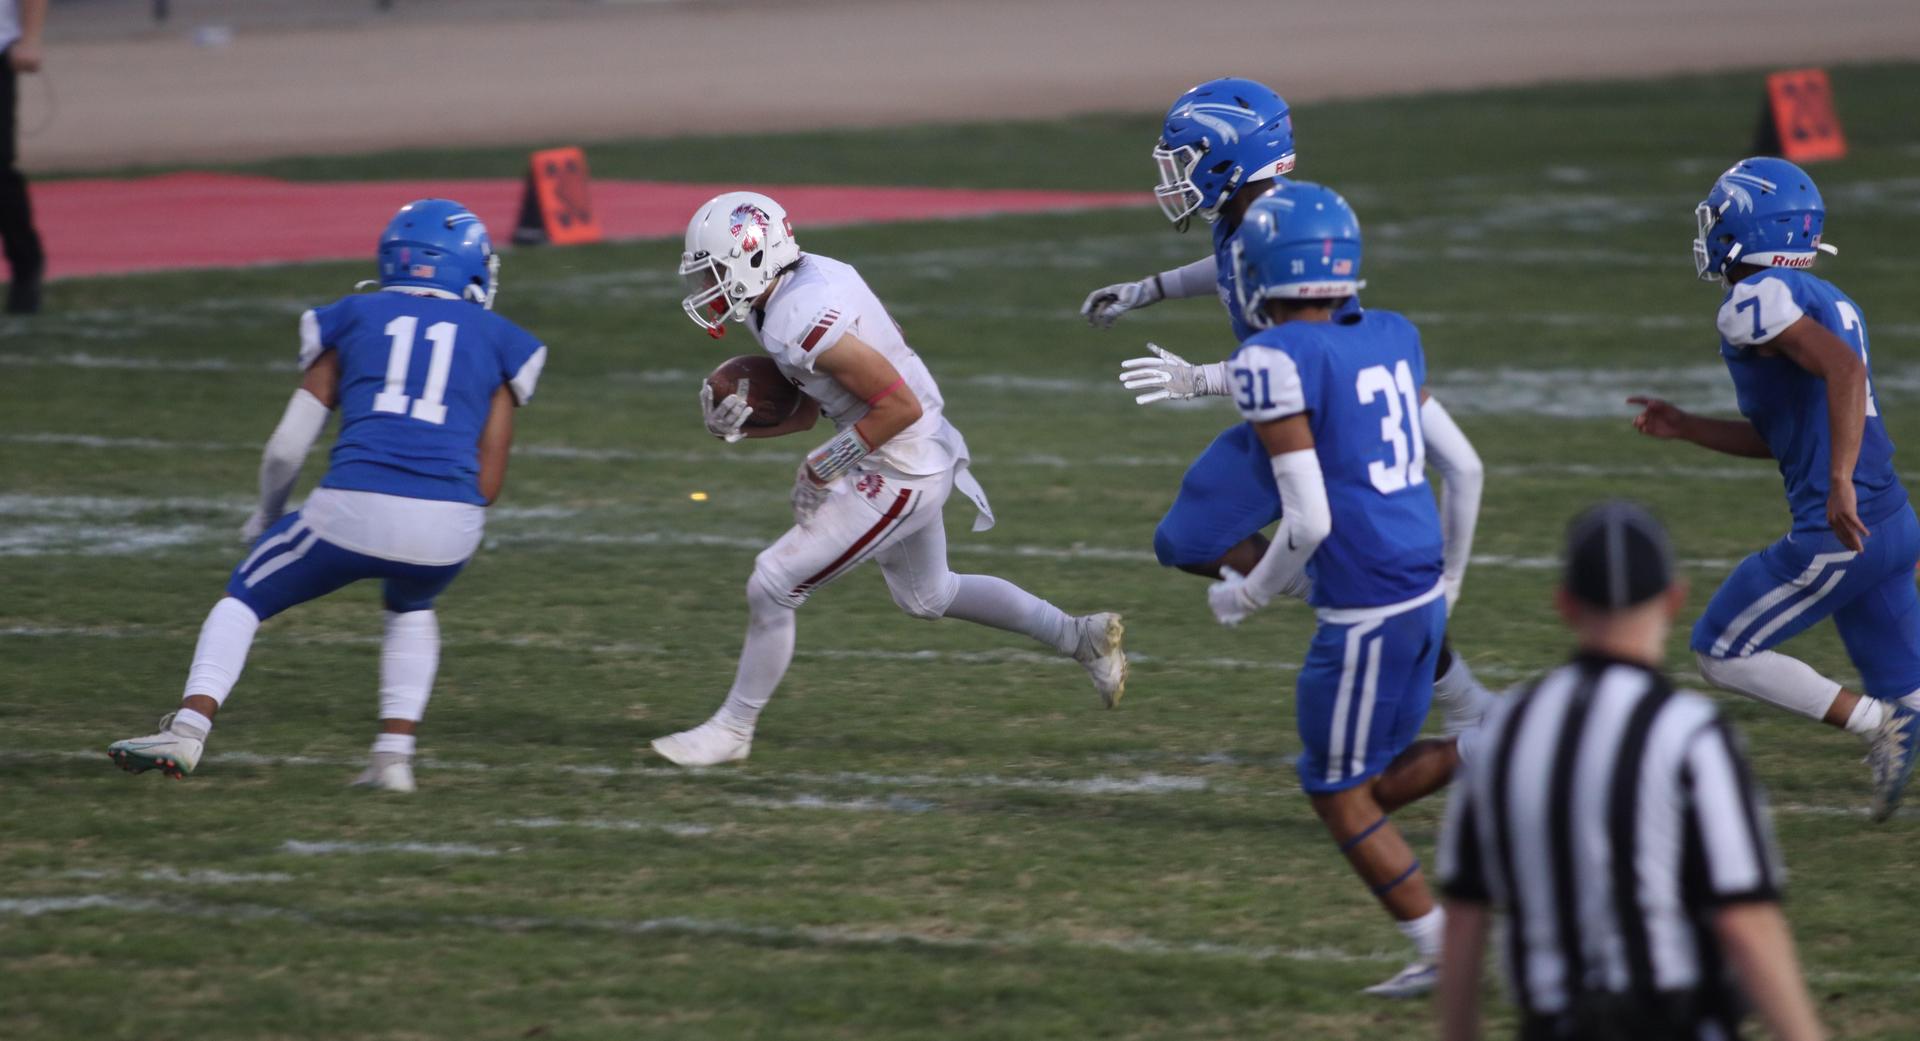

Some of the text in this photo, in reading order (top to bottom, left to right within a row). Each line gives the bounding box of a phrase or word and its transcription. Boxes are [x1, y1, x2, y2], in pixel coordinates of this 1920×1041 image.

[1735, 295, 1767, 340] 7
[372, 315, 459, 425] 11
[1234, 368, 1276, 410] 31
[1356, 359, 1426, 495] 31
